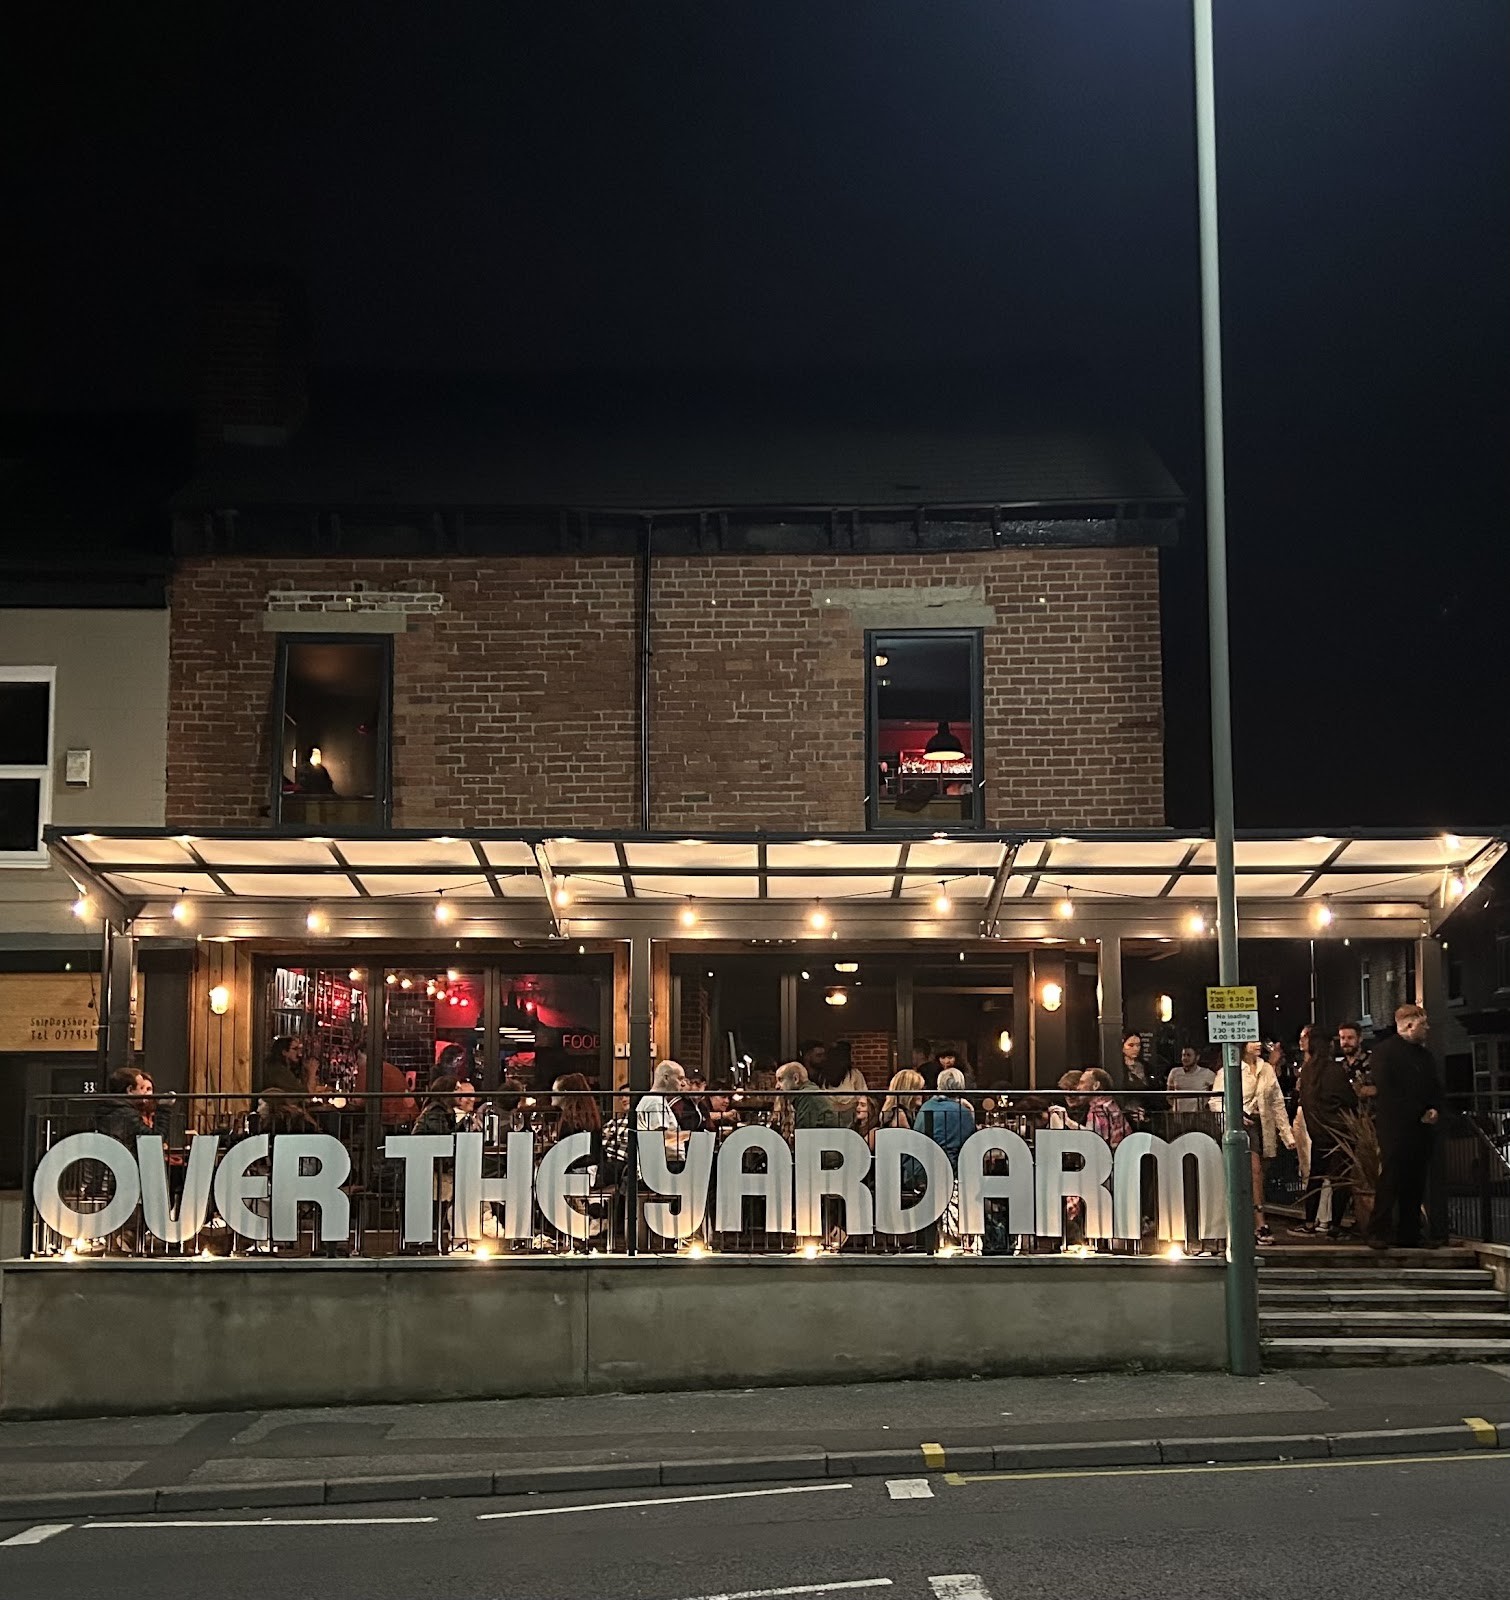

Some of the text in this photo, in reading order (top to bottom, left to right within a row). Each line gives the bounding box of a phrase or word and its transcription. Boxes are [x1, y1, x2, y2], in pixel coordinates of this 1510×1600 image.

[31, 1030, 48, 1040] Tel
[33, 1127, 1228, 1243] OVER THE YARDARM
